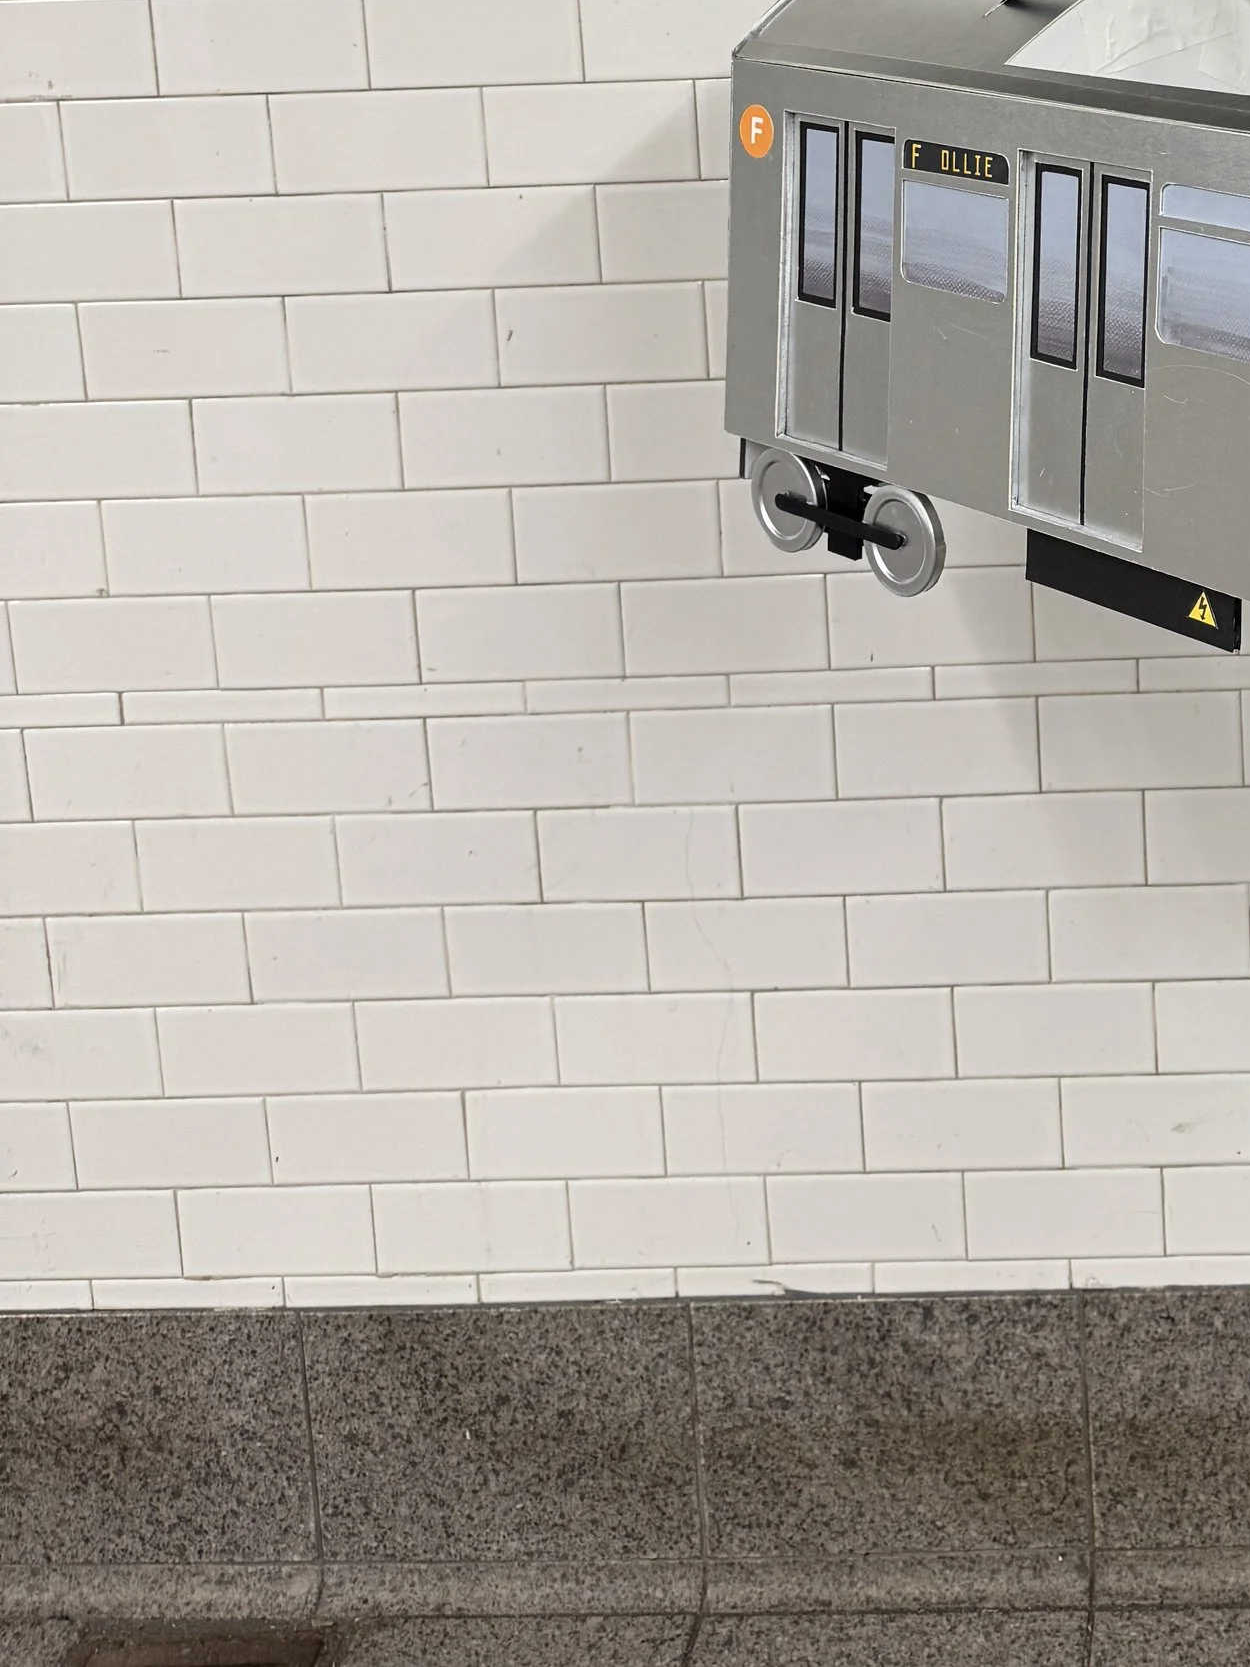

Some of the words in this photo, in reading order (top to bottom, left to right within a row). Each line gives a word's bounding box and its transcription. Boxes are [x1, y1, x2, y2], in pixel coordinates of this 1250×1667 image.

[751, 116, 763, 144] F
[911, 143, 922, 168] F
[941, 149, 993, 178] OLLIE
